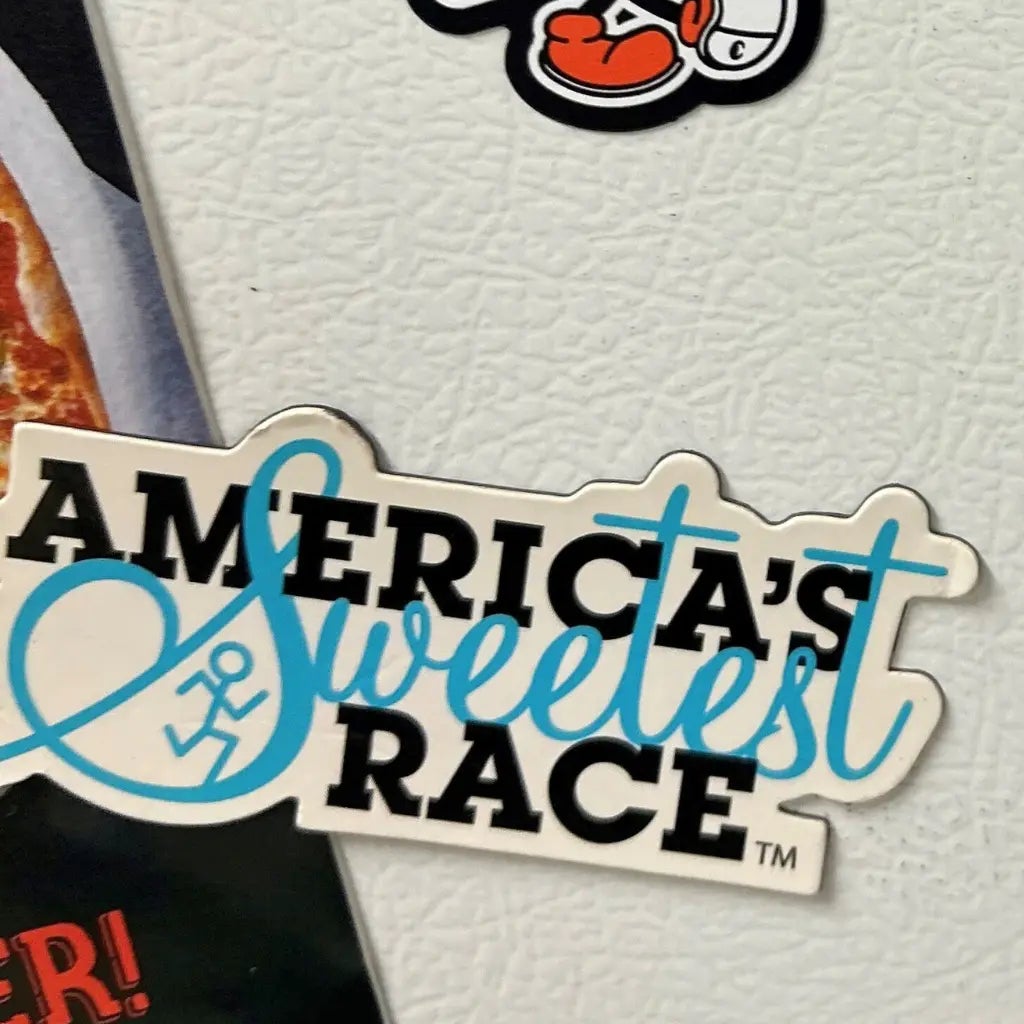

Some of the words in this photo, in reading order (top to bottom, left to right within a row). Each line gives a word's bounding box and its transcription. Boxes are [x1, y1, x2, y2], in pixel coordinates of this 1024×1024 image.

[0, 438, 949, 804] Sweetest
[5, 457, 875, 672] AMERICA'S
[324, 703, 759, 862] RACE
